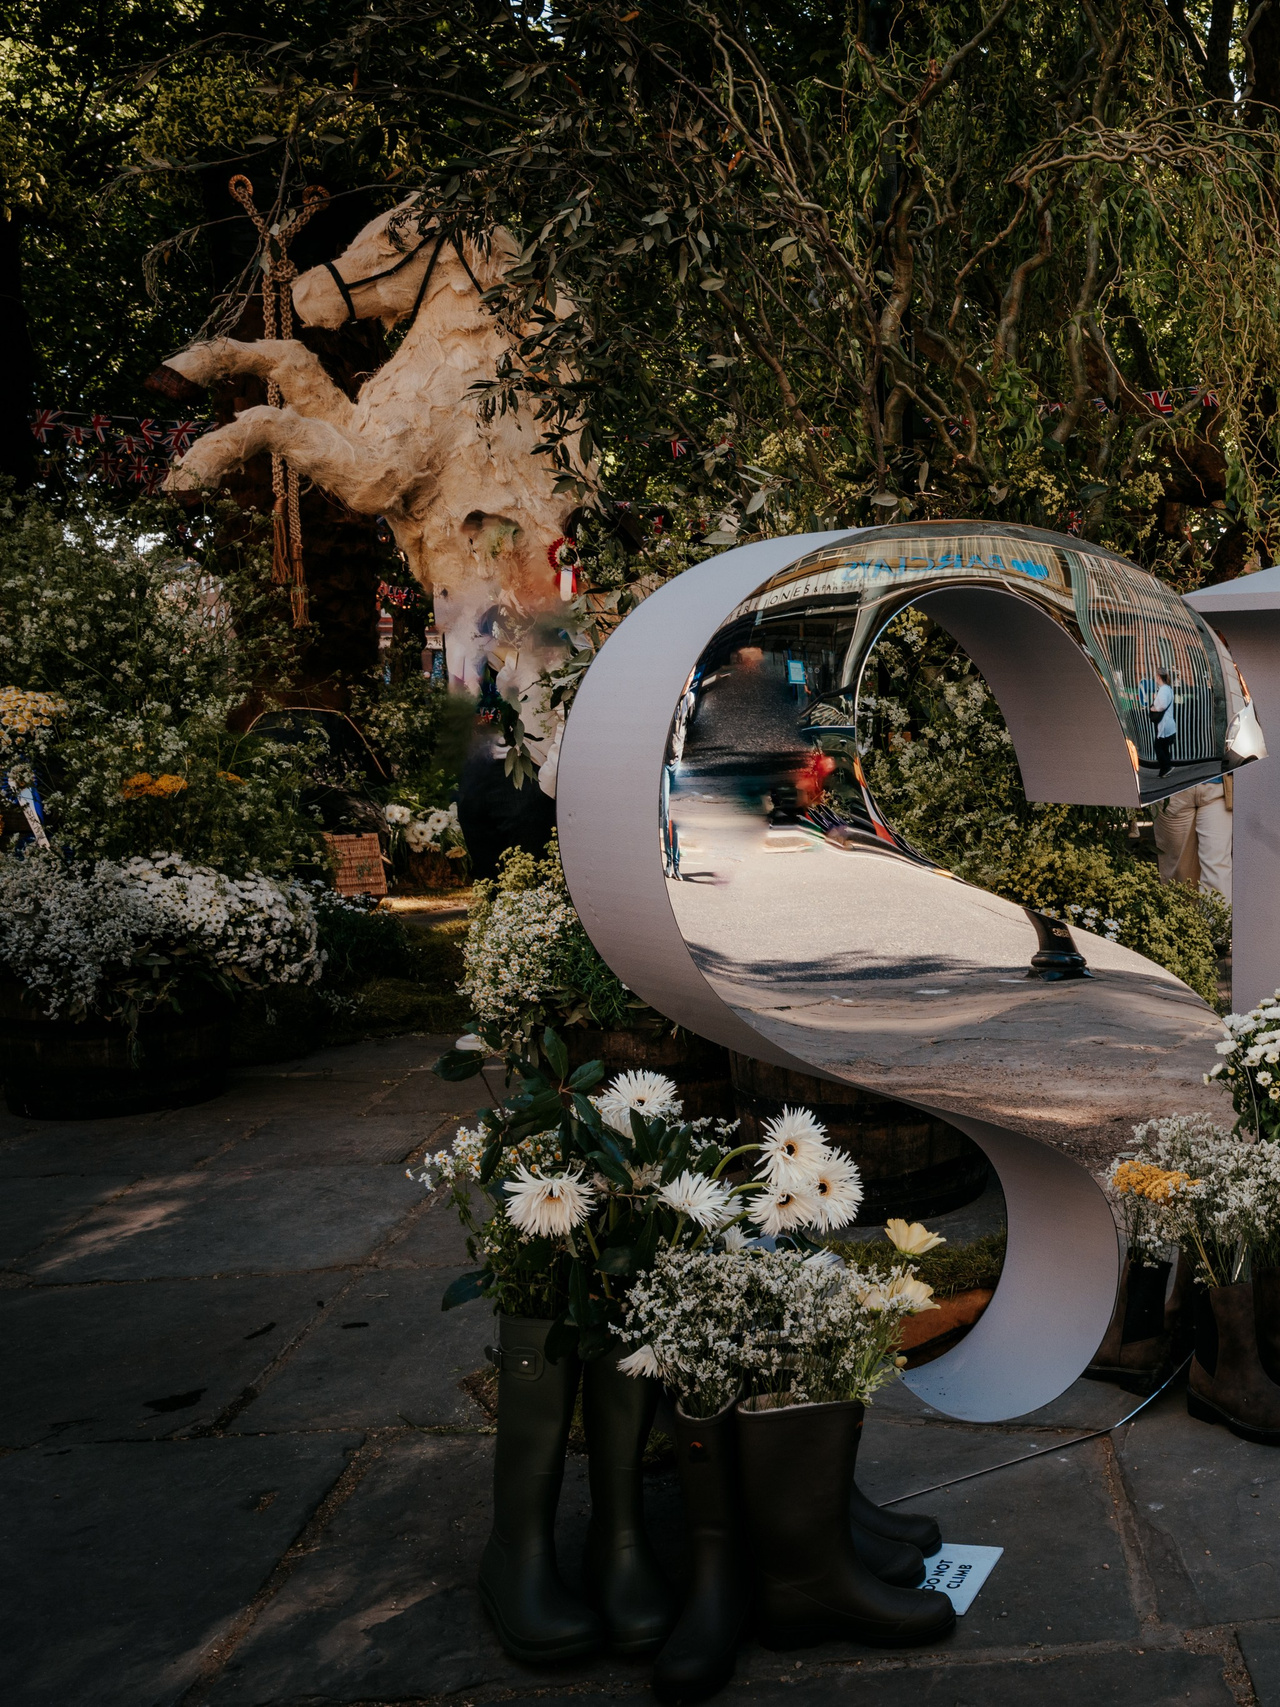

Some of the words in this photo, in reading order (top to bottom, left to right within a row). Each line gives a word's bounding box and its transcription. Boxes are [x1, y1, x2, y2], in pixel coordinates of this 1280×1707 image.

[931, 1559, 953, 1577] NOT
[946, 1564, 972, 1589] CLIMB
[922, 1577, 941, 1591] DO
